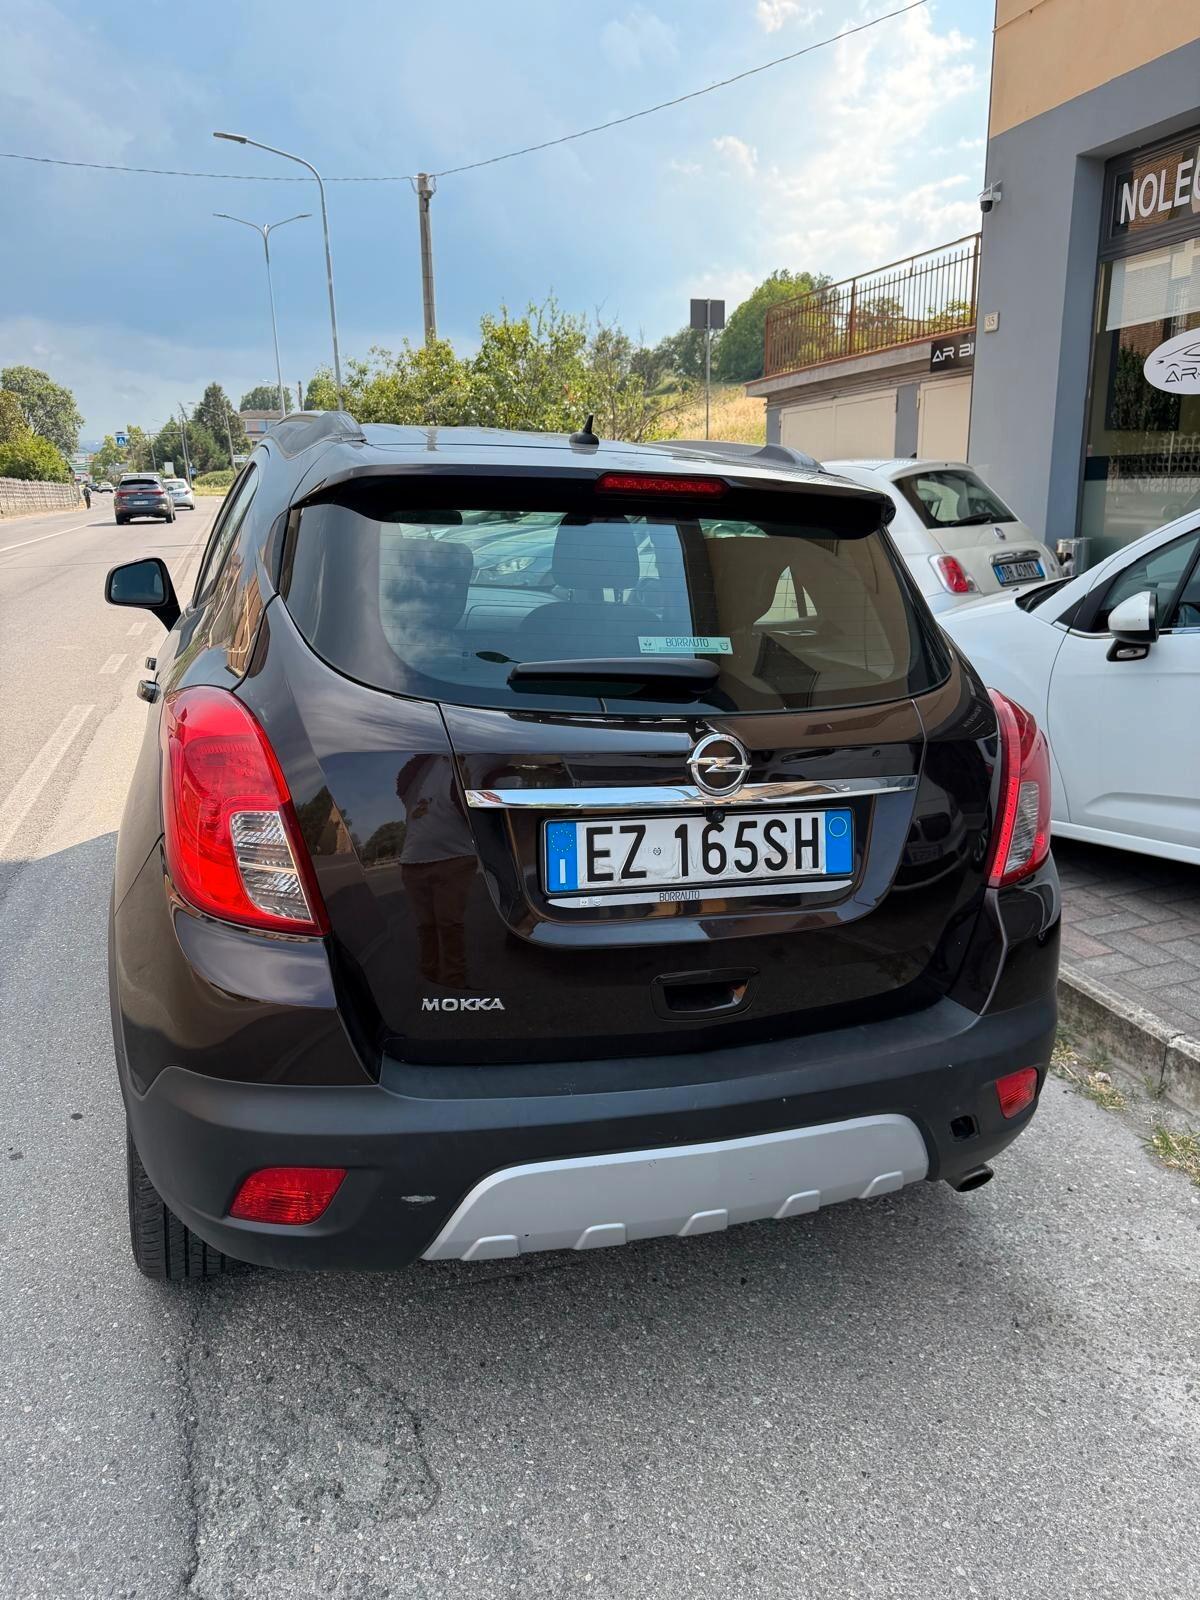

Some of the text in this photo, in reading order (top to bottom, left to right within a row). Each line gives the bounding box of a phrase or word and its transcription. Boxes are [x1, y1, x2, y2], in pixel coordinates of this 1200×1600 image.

[932, 346, 955, 363] AR
[665, 637, 710, 648] BORRAUTO
[586, 816, 820, 883] EZ 165SH
[659, 889, 700, 902] BORRAUTO
[421, 997, 506, 1012] MOKKA
